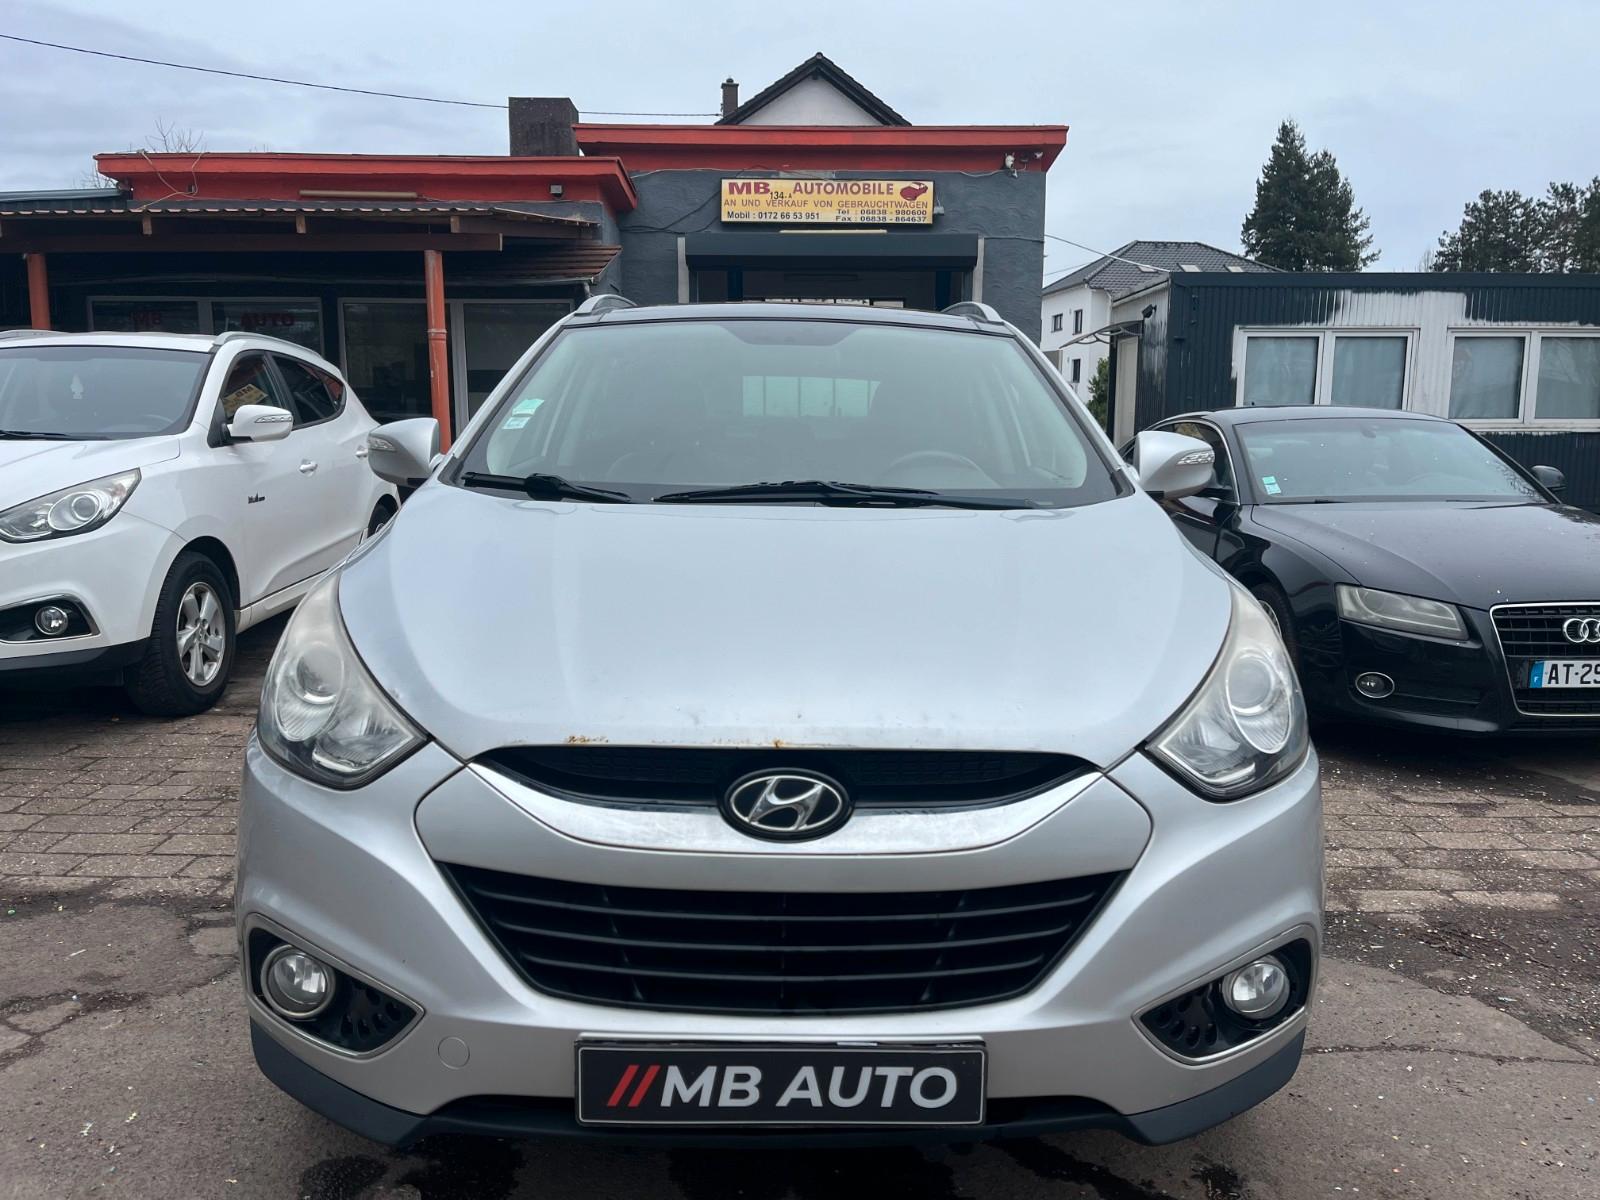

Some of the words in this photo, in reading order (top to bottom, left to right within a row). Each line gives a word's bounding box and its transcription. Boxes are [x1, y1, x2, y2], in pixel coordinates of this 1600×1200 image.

[728, 182, 770, 195] MB
[793, 182, 894, 195] AUTOMOBILE
[724, 199, 736, 207] AN
[742, 199, 760, 207] UND
[766, 199, 808, 208] VERKAUF
[814, 200, 833, 208] VON
[837, 200, 928, 209] GEBRAUCHTWAGEN
[727, 211, 750, 219] Mobil
[805, 212, 820, 220] 951
[775, 1065, 958, 1109] AUTO
